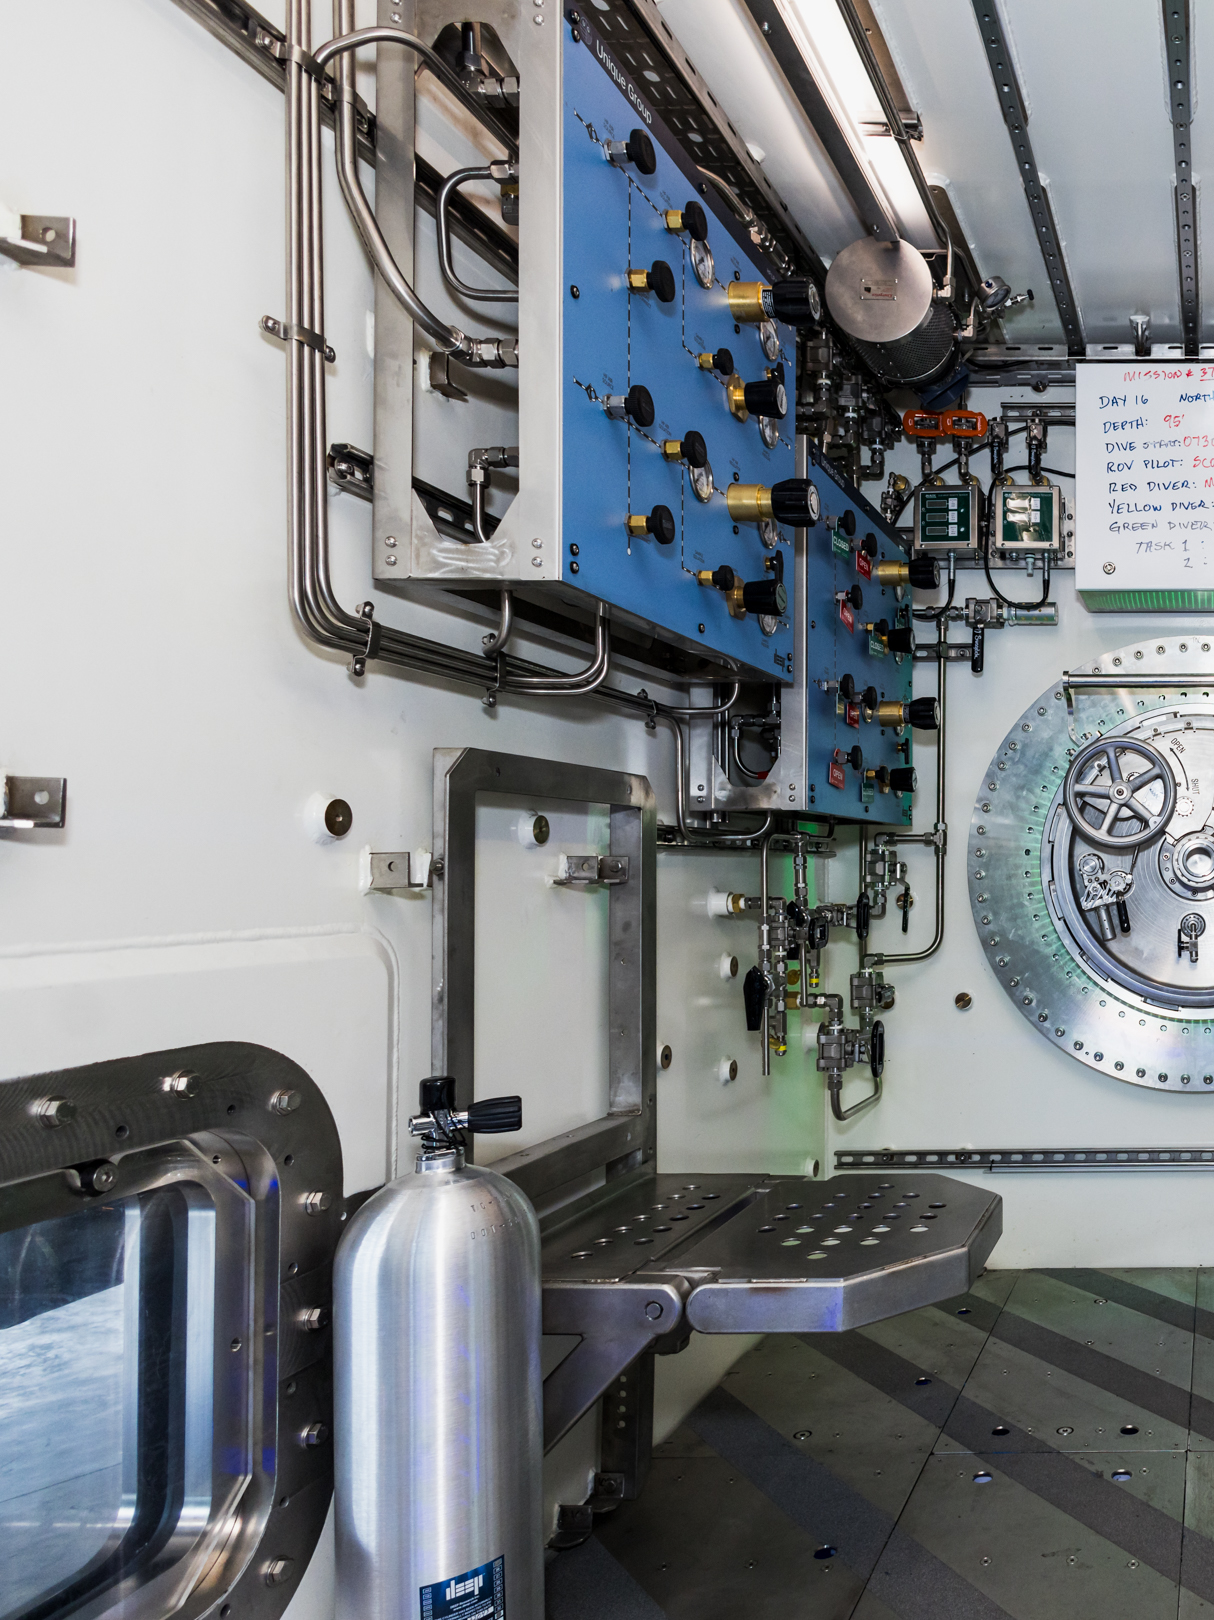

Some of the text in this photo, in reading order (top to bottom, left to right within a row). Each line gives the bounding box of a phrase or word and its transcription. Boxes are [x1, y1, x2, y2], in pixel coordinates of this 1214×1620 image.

[596, 39, 626, 90] Unique
[627, 83, 652, 124] Group
[1099, 395, 1127, 409] DAY
[1135, 394, 1149, 405] 16
[1102, 413, 1185, 434] DEPTH: 95'
[1105, 440, 1137, 454] DIVE
[1106, 460, 1135, 474] ROV
[1143, 459, 1184, 470] PILOT:
[1108, 482, 1138, 494] RED
[1146, 480, 1198, 492] DIVER:
[1108, 499, 1162, 515] YELLOW
[1108, 519, 1159, 534] GREEN
[832, 535, 850, 552] CLOSED
[1135, 540, 1176, 554] TASK
[859, 557, 869, 571] OPEN
[1183, 557, 1194, 569] 2
[1170, 737, 1187, 755] OPEN
[832, 768, 843, 781] OPEN
[1190, 778, 1200, 795] SHUT
